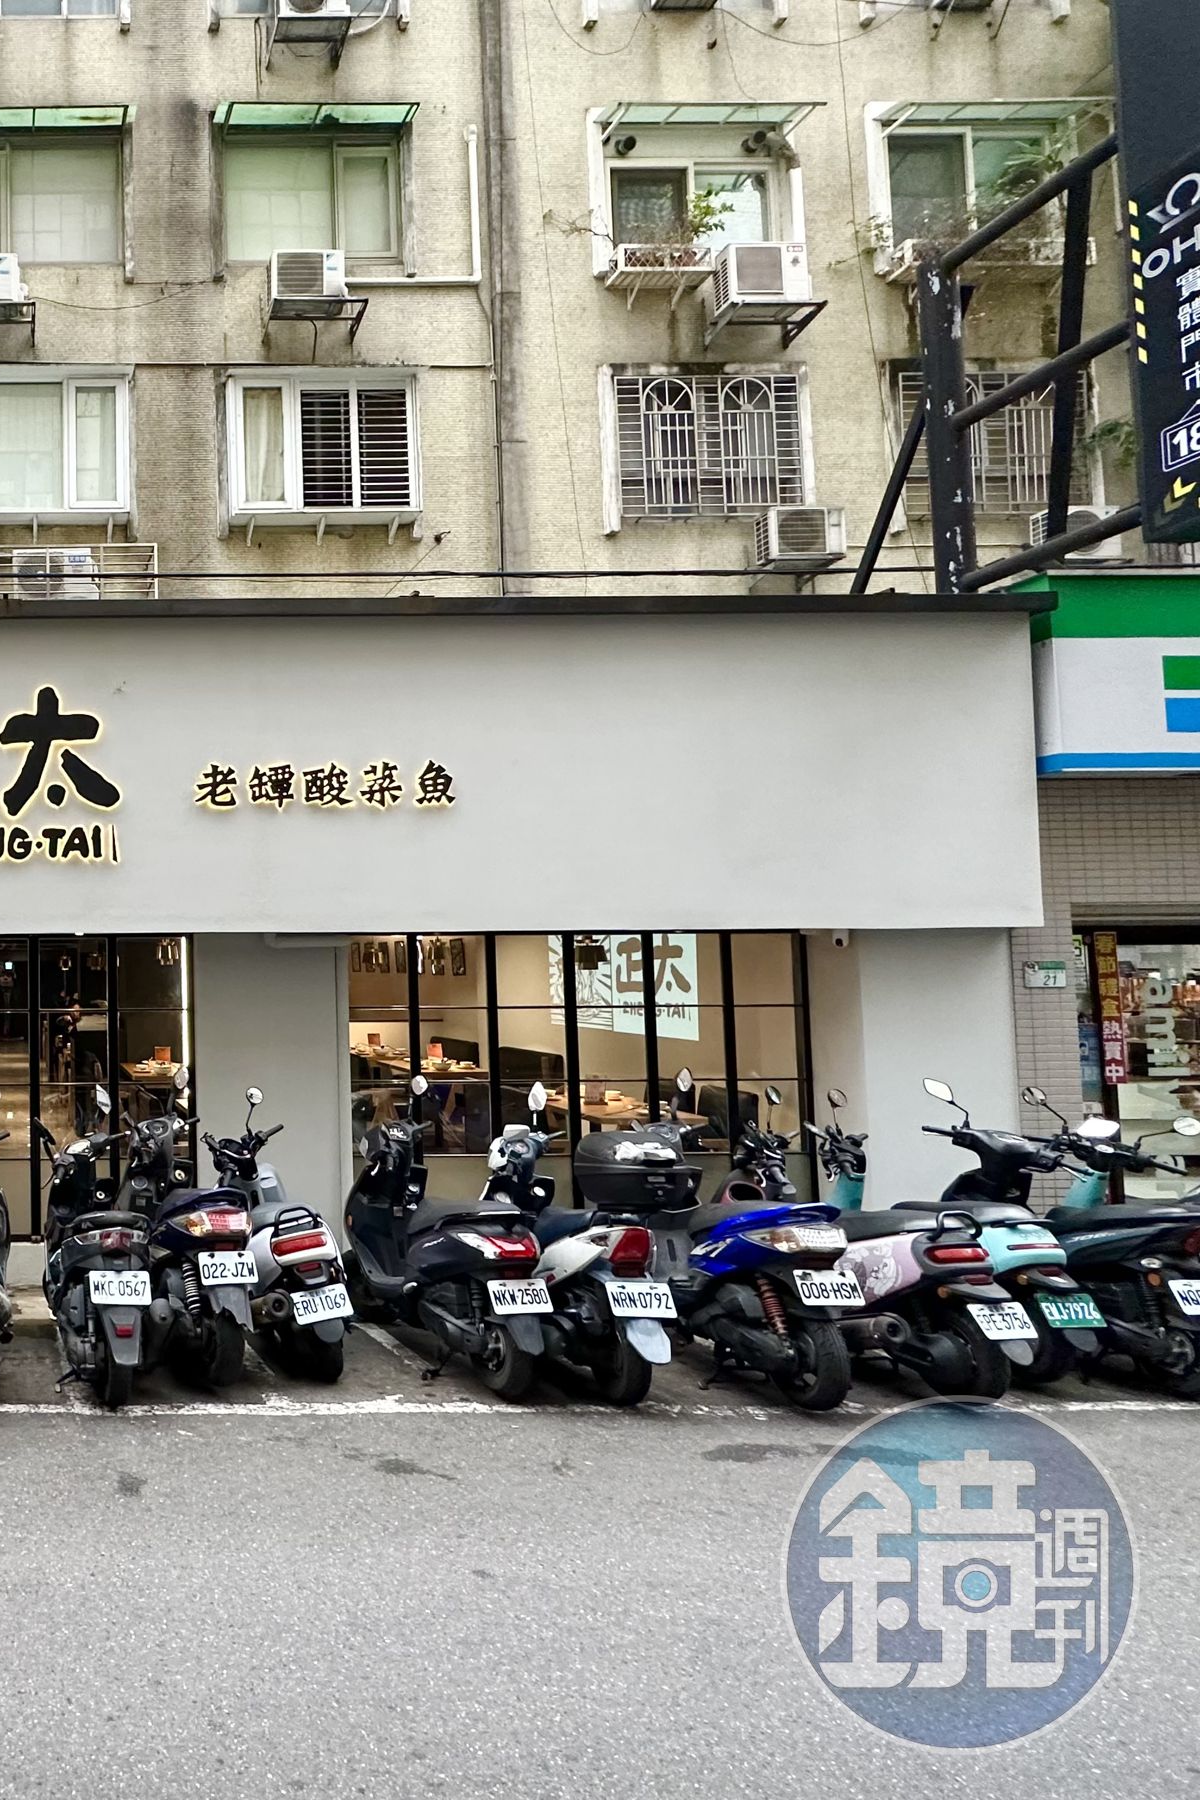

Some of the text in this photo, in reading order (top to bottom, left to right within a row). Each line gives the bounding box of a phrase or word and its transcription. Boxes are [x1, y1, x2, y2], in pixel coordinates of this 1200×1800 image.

[196, 760, 455, 807] 老罈酸菜魚
[1043, 974, 1057, 986] 21
